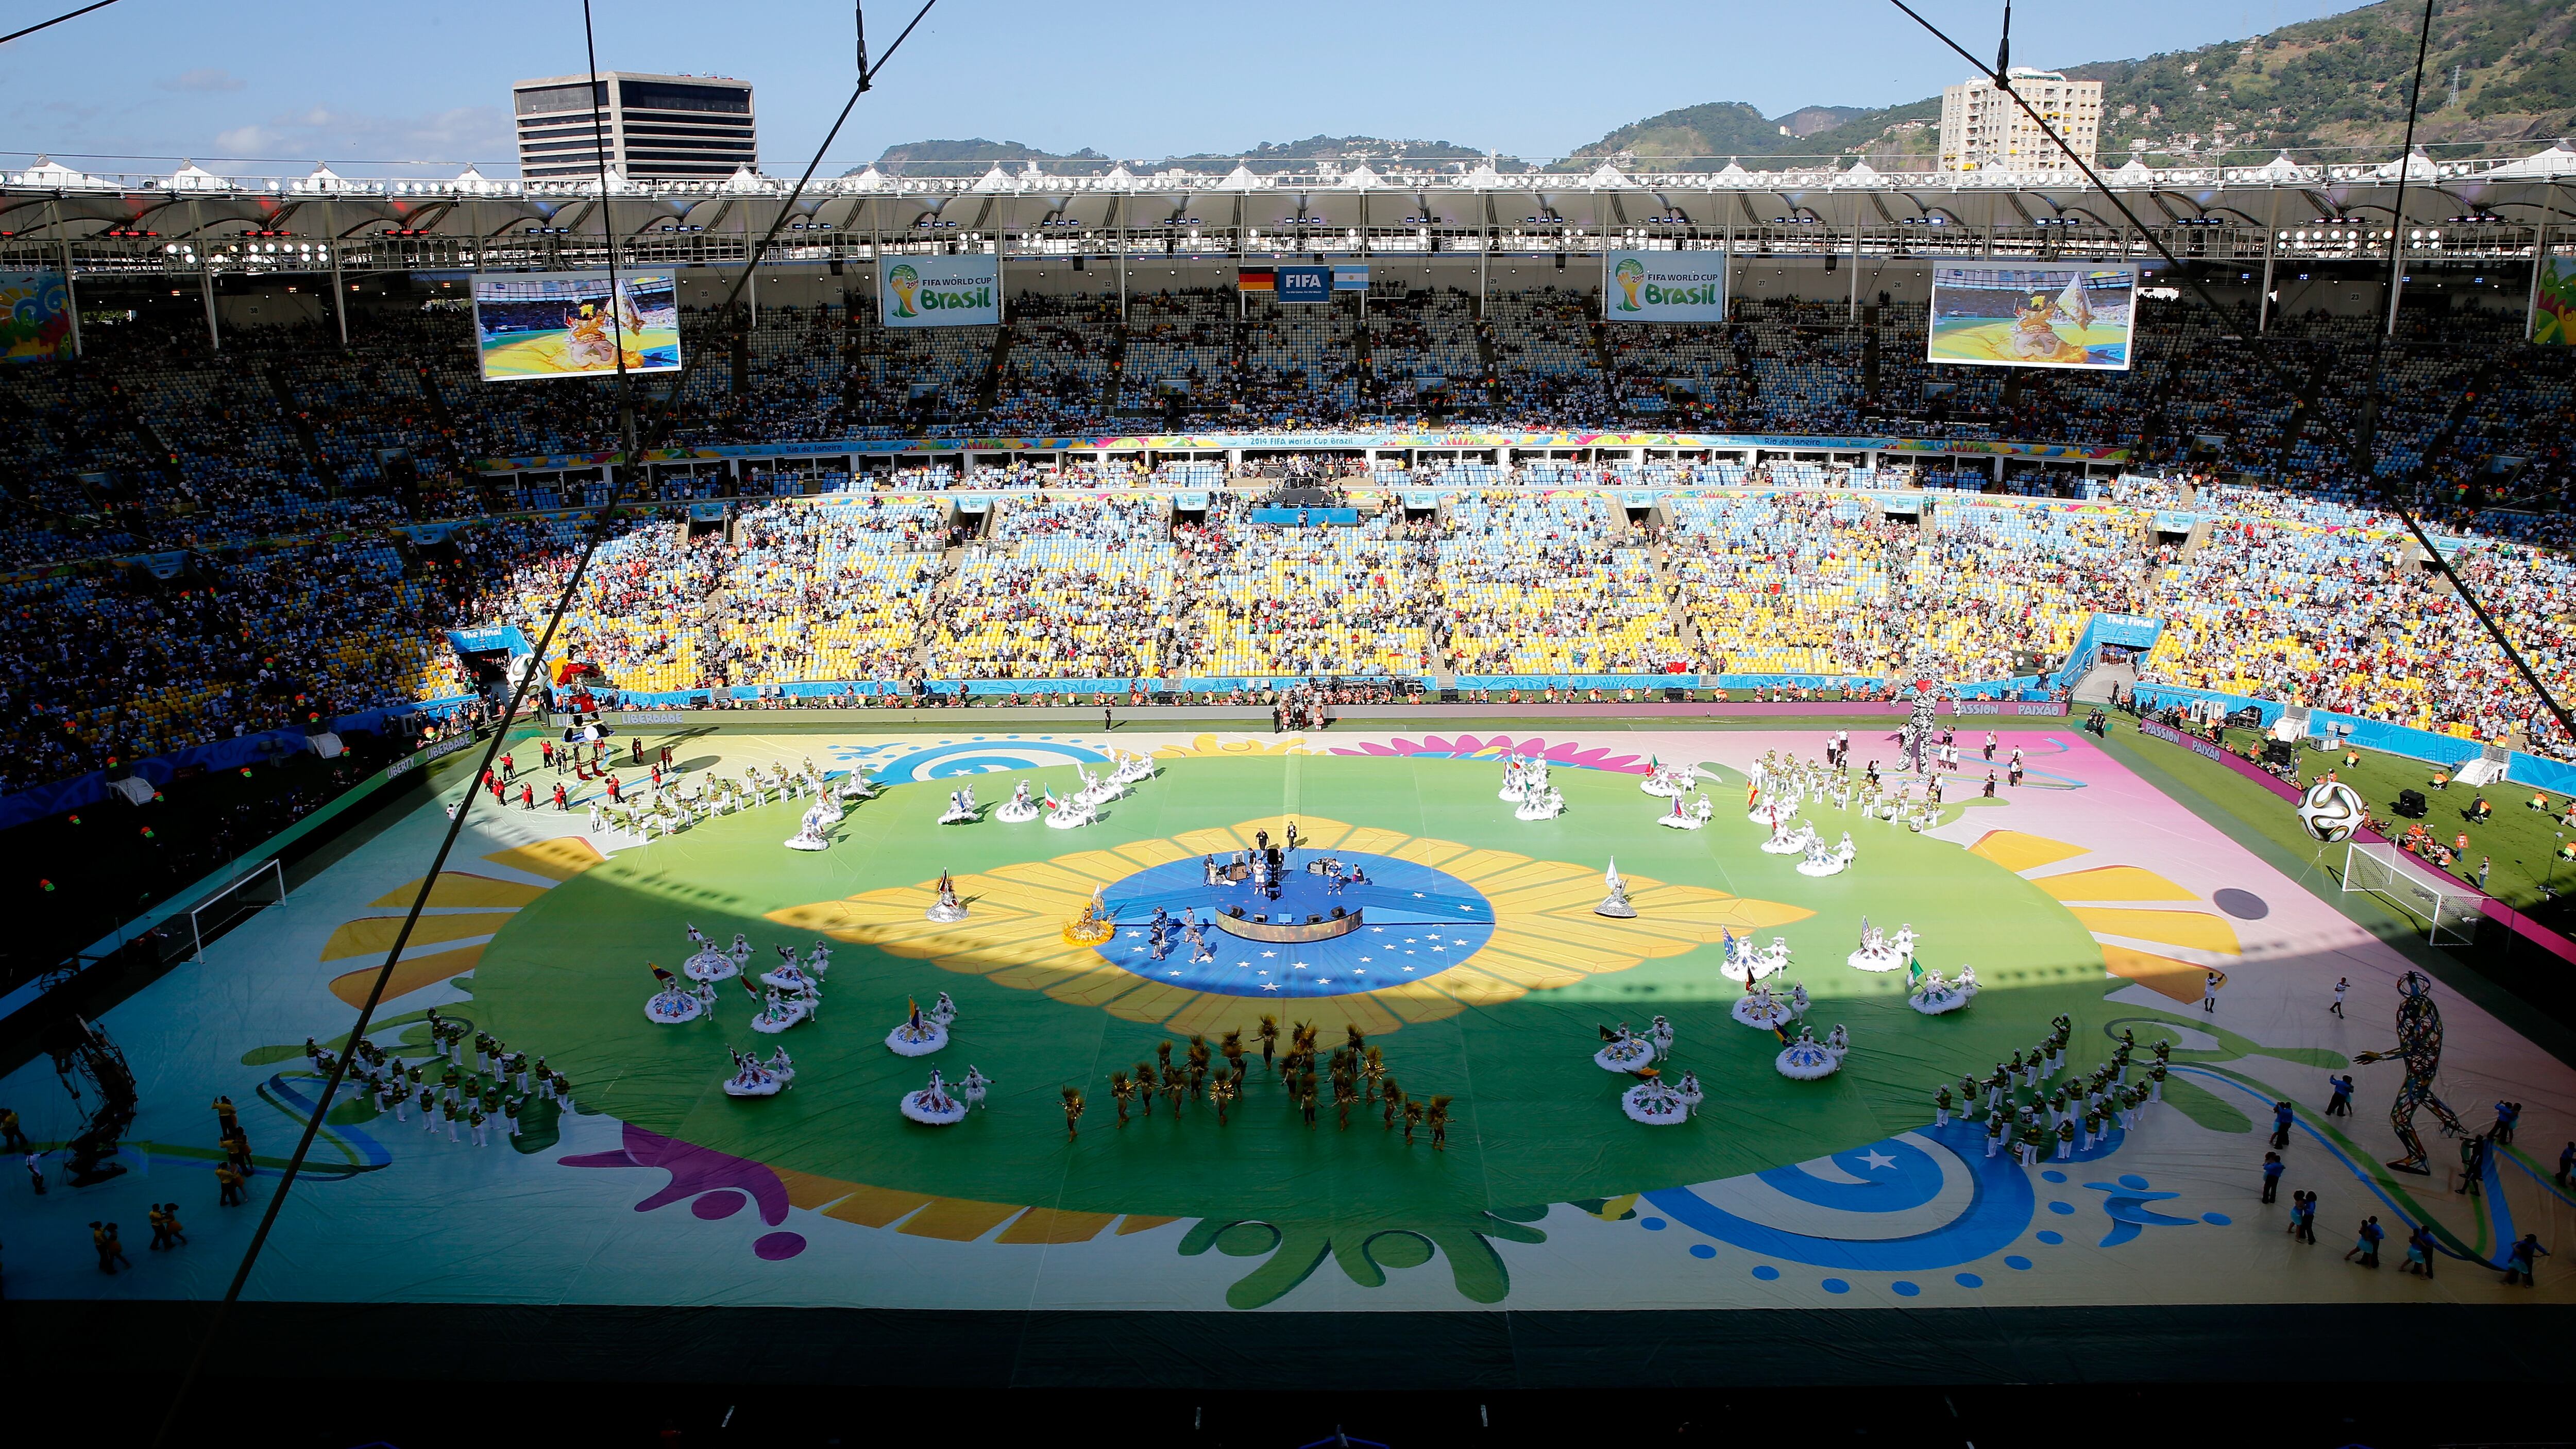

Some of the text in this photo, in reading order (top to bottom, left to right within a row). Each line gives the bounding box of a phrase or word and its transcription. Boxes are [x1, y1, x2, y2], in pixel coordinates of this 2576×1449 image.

[906, 279, 919, 289] 2014
[1286, 275, 1321, 288] FIFA
[1631, 274, 1644, 283] 2014
[921, 287, 991, 310] Brasil
[1645, 283, 1716, 305] Brasil
[2106, 614, 2155, 628] The Final
[461, 628, 502, 639] The Final
[1959, 704, 1999, 715] ASSION
[2018, 703, 2059, 716] PAIXÃO
[621, 713, 684, 724] LIBERDADE
[2146, 722, 2180, 744] PASSION
[426, 733, 471, 760] LIBERDADE
[2192, 740, 2221, 762] PAIXÃO
[387, 756, 415, 780] LIBERTY
